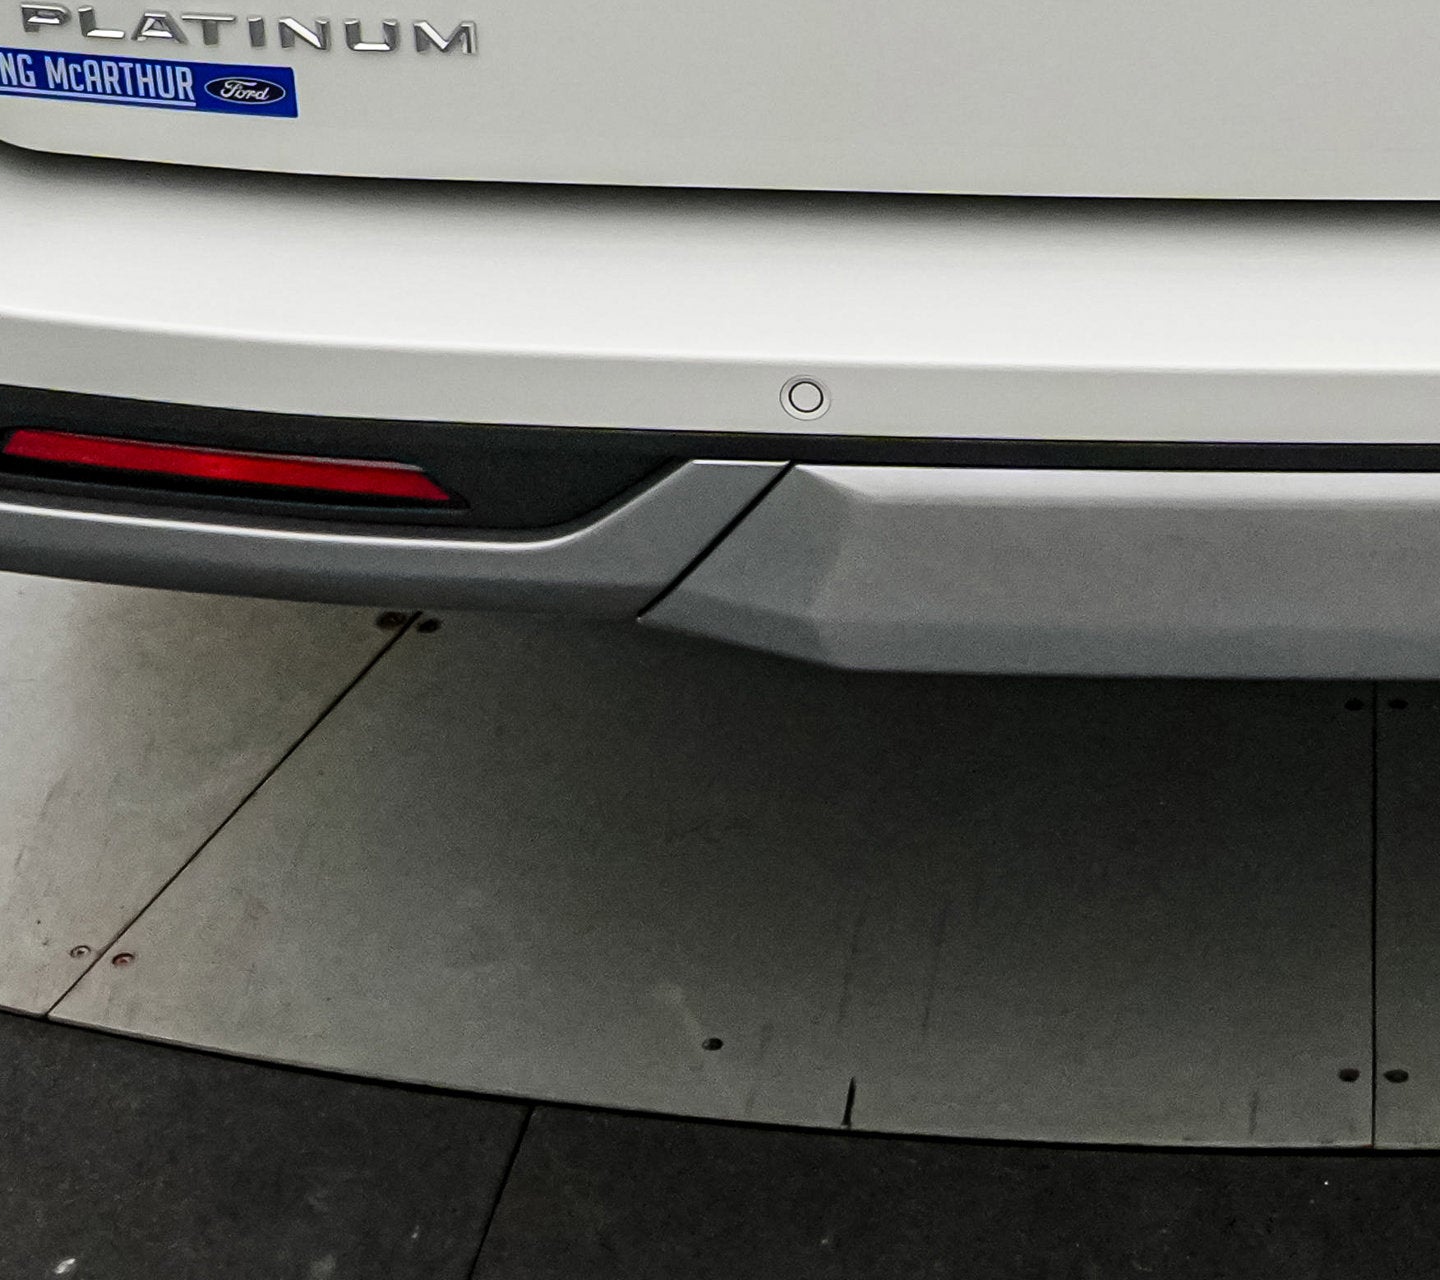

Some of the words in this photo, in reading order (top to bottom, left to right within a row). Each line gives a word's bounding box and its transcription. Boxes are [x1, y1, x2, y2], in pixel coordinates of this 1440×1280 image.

[20, 2, 478, 55] PLATINUM
[45, 56, 196, 101] McARTHUR
[219, 78, 271, 102] Ford
